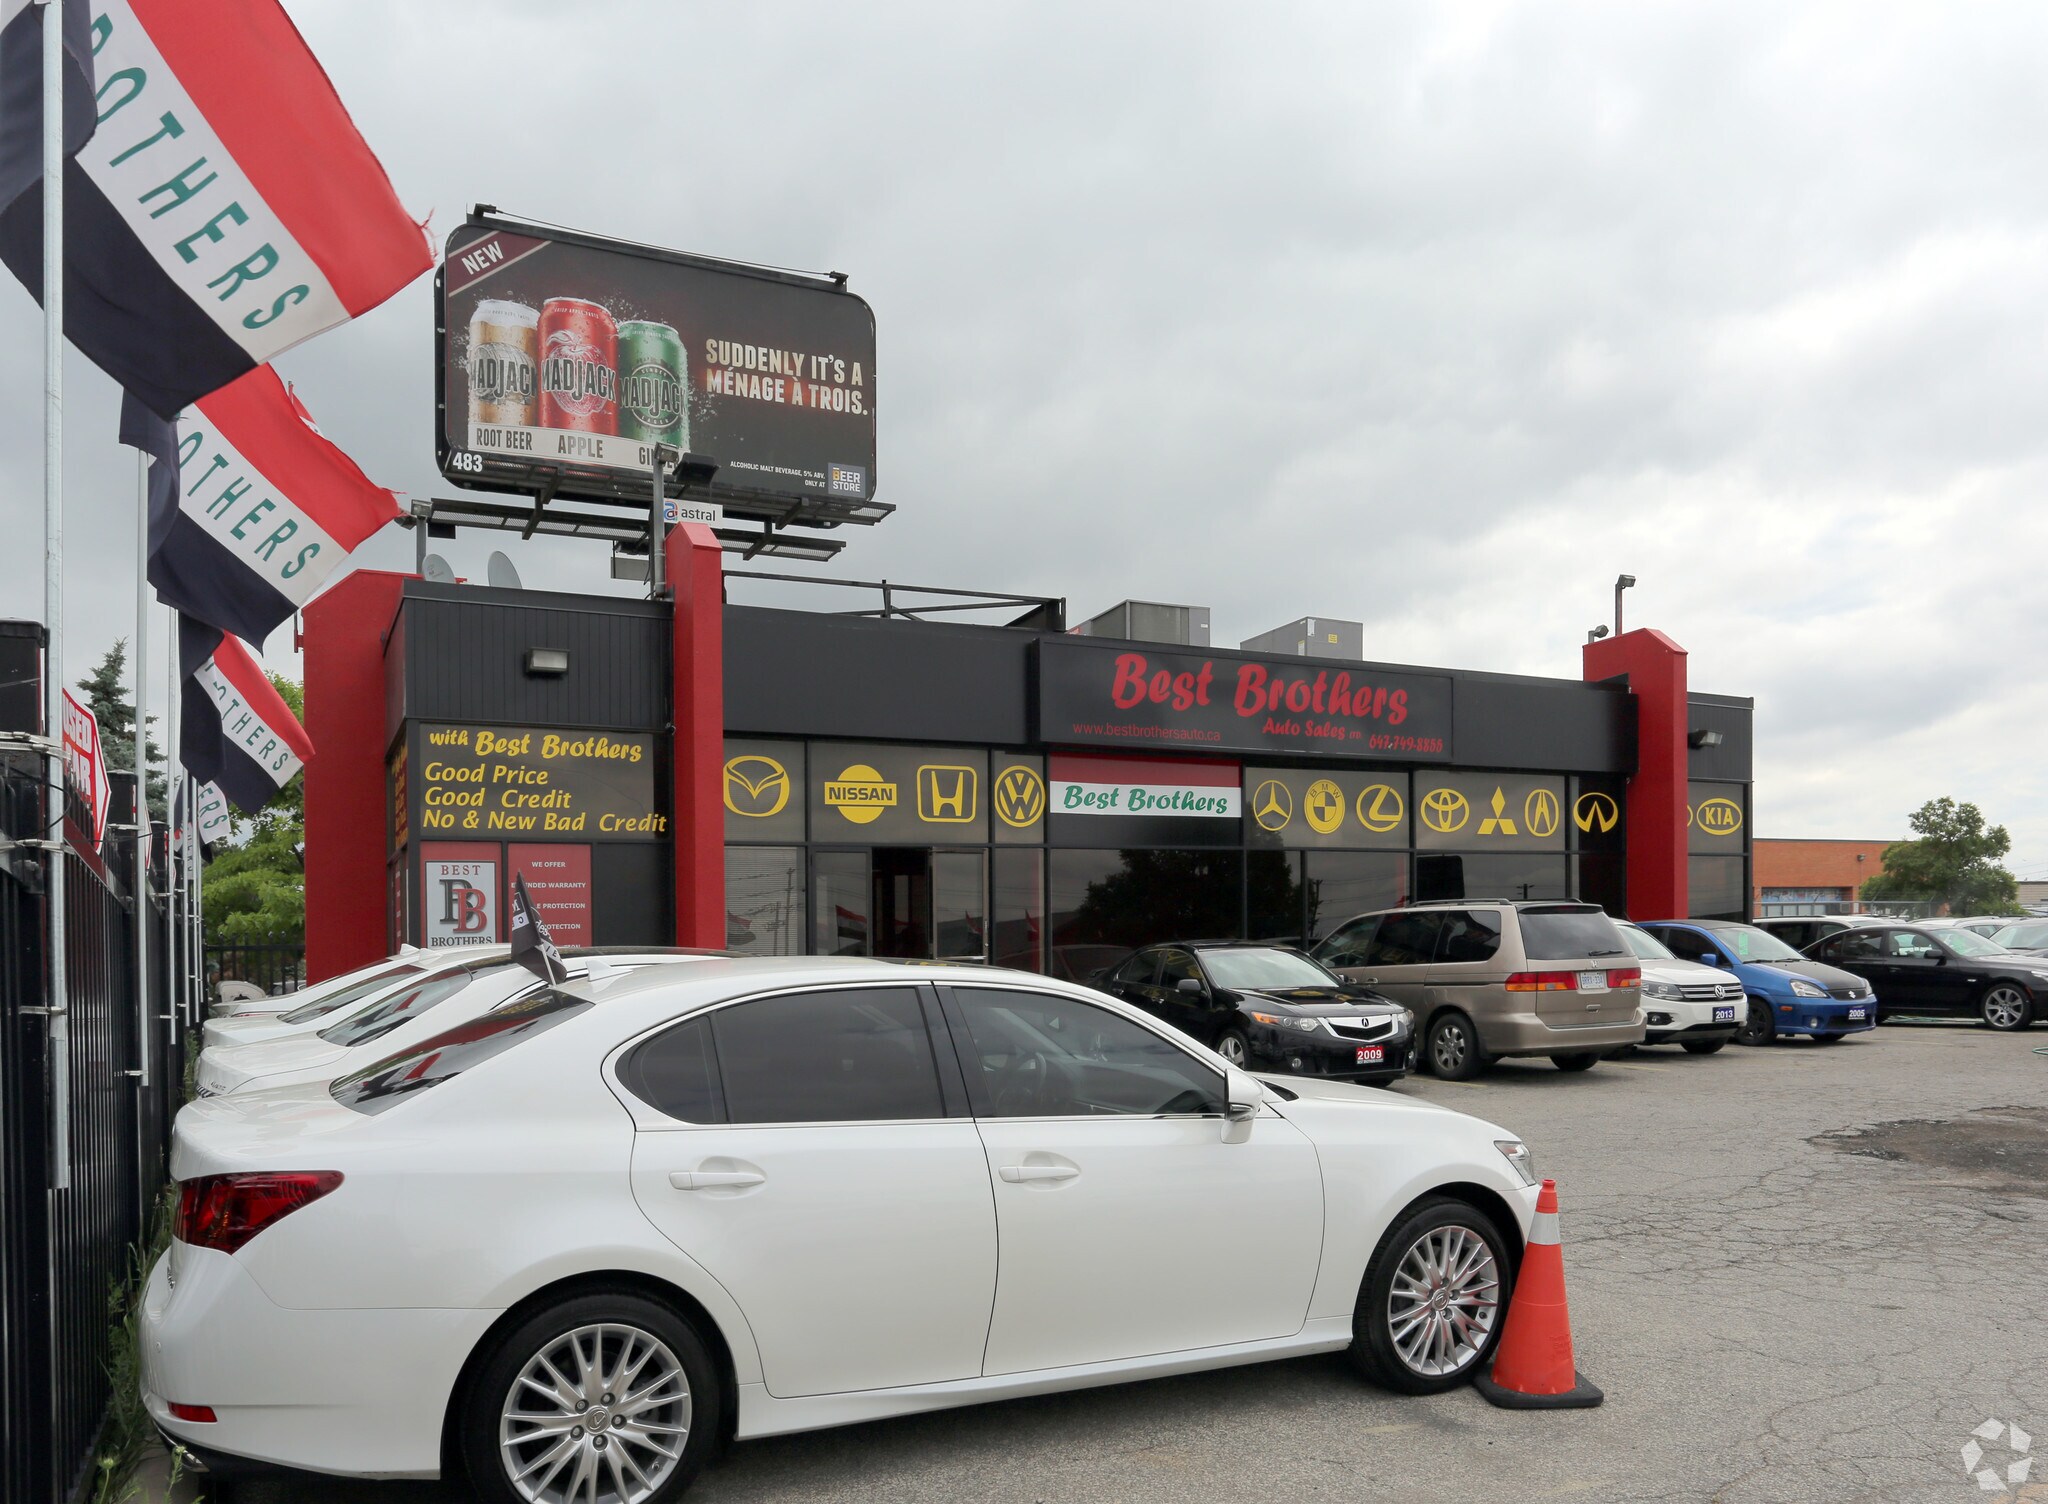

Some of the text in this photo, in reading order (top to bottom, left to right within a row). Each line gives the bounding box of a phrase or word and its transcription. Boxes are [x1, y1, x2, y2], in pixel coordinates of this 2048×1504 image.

[461, 241, 504, 275] NEW
[705, 338, 863, 386] SUDDENLY IT'S A
[541, 358, 616, 403] MADJACK
[706, 366, 868, 416] MÉNAGE À TROIS.
[620, 376, 686, 417] MADJACK
[476, 429, 532, 451] ROOT BEER
[558, 435, 604, 459] APPLE
[453, 452, 483, 472] 483
[730, 460, 759, 471] ALCOHOLIC
[775, 467, 802, 477] BEVERAGE,
[804, 479, 817, 487] ONLY
[832, 468, 861, 484] BEER
[832, 481, 861, 493] STORE
[681, 508, 716, 522] astral
[1111, 653, 1408, 726] Best Brothers
[63, 694, 92, 754] USED
[1072, 722, 1221, 742] www.bestbrothersauto.ca
[1262, 717, 1301, 737] Auto
[1305, 719, 1346, 741] Sales
[430, 729, 642, 763] with Best Brothers
[424, 762, 549, 785] Good Price
[425, 786, 572, 809] Good Credit
[828, 786, 893, 801] NISSAN
[1063, 785, 1228, 815] Best Brothers
[1309, 783, 1341, 799] BMW
[423, 809, 667, 833] No & New Bad Credit
[1705, 806, 1734, 825] KIA
[441, 865, 481, 876] BEST
[431, 936, 493, 947] BROTHERS
[1715, 1009, 1734, 1019] 2013
[1848, 1009, 1866, 1018] 2005
[1357, 1049, 1382, 1061] 2009
